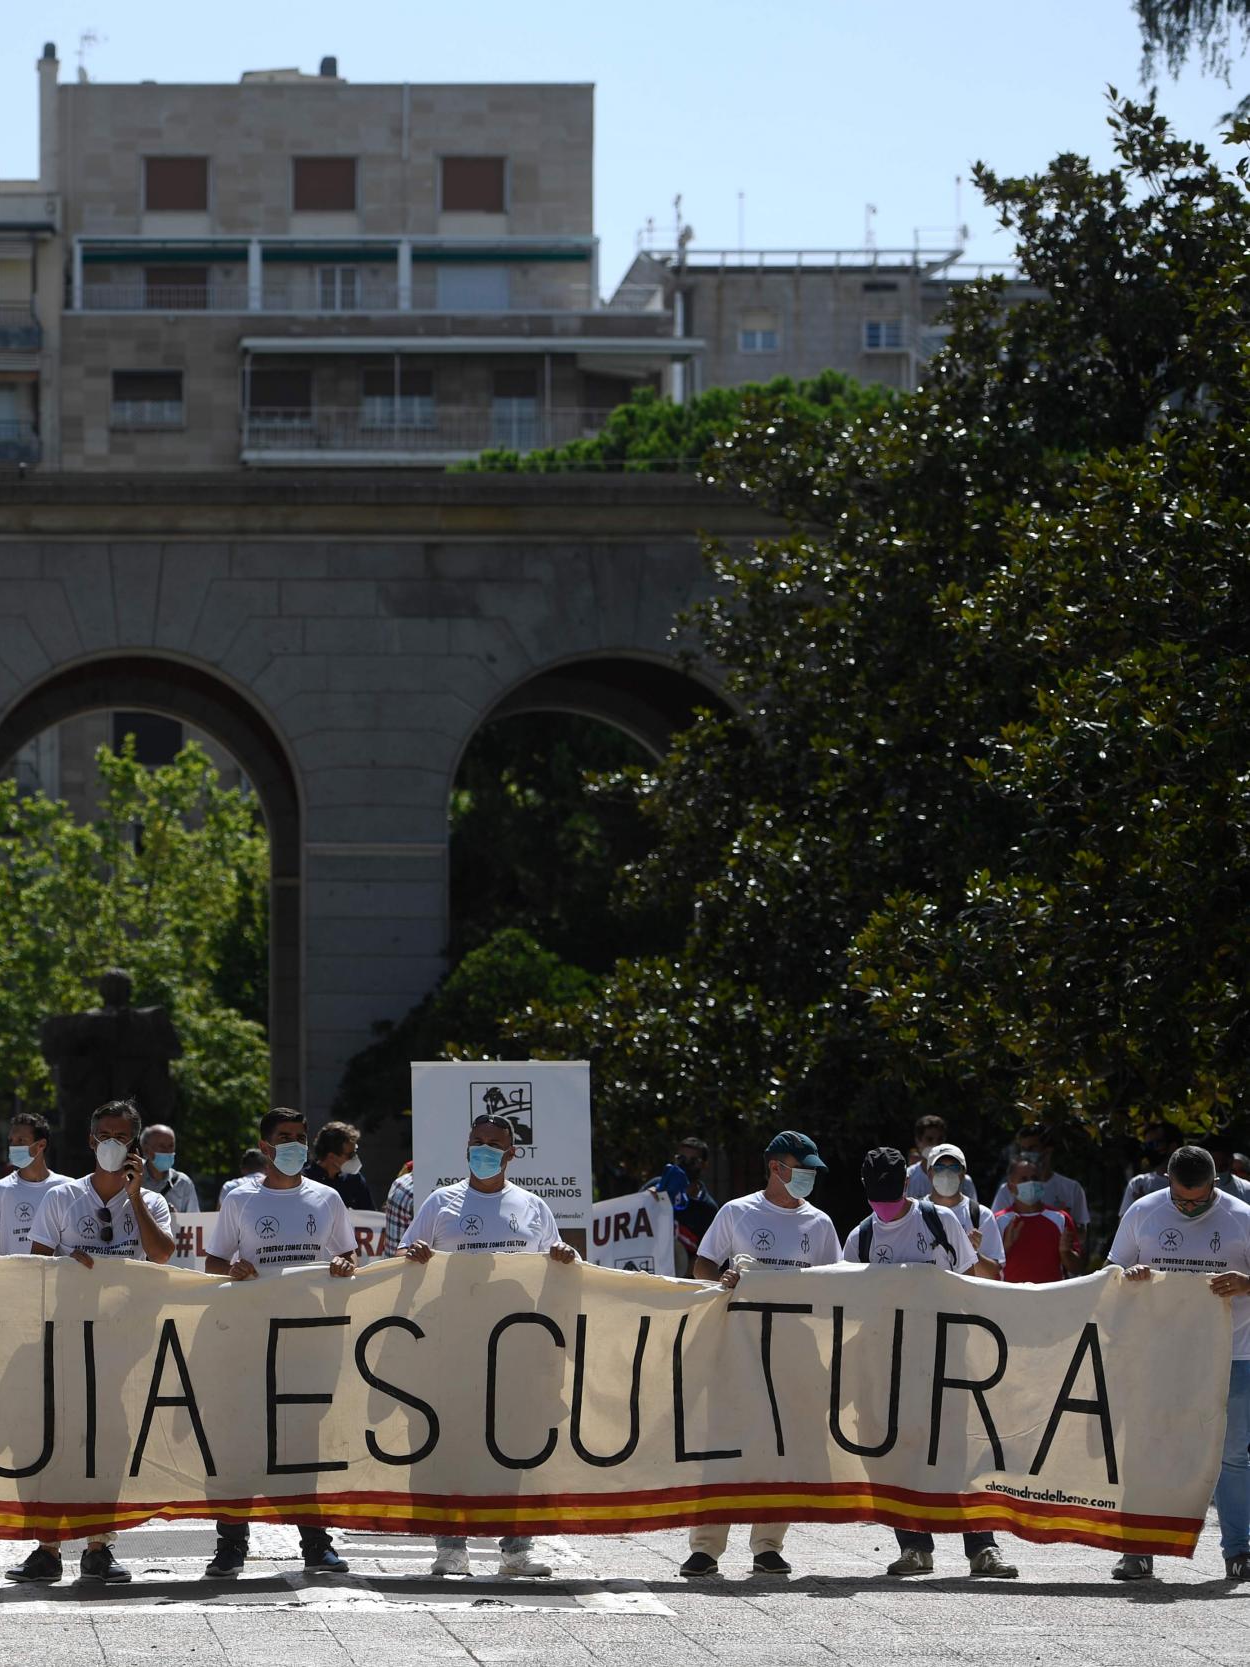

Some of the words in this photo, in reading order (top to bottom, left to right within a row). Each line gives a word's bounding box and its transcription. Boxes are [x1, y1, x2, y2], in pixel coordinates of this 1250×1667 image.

[508, 1177, 559, 1186] SINDICAL
[561, 1177, 577, 1186] DE
[284, 1243, 301, 1251] SOMOS
[457, 1243, 466, 1251] LOS
[467, 1242, 488, 1250] TOREROS
[270, 1255, 276, 1263] LA
[1162, 1257, 1185, 1265] TOREROS
[265, 1315, 441, 1476] ES
[484, 1302, 1120, 1486] CULTURA
[985, 1480, 1116, 1509] alexandradelbene.com
